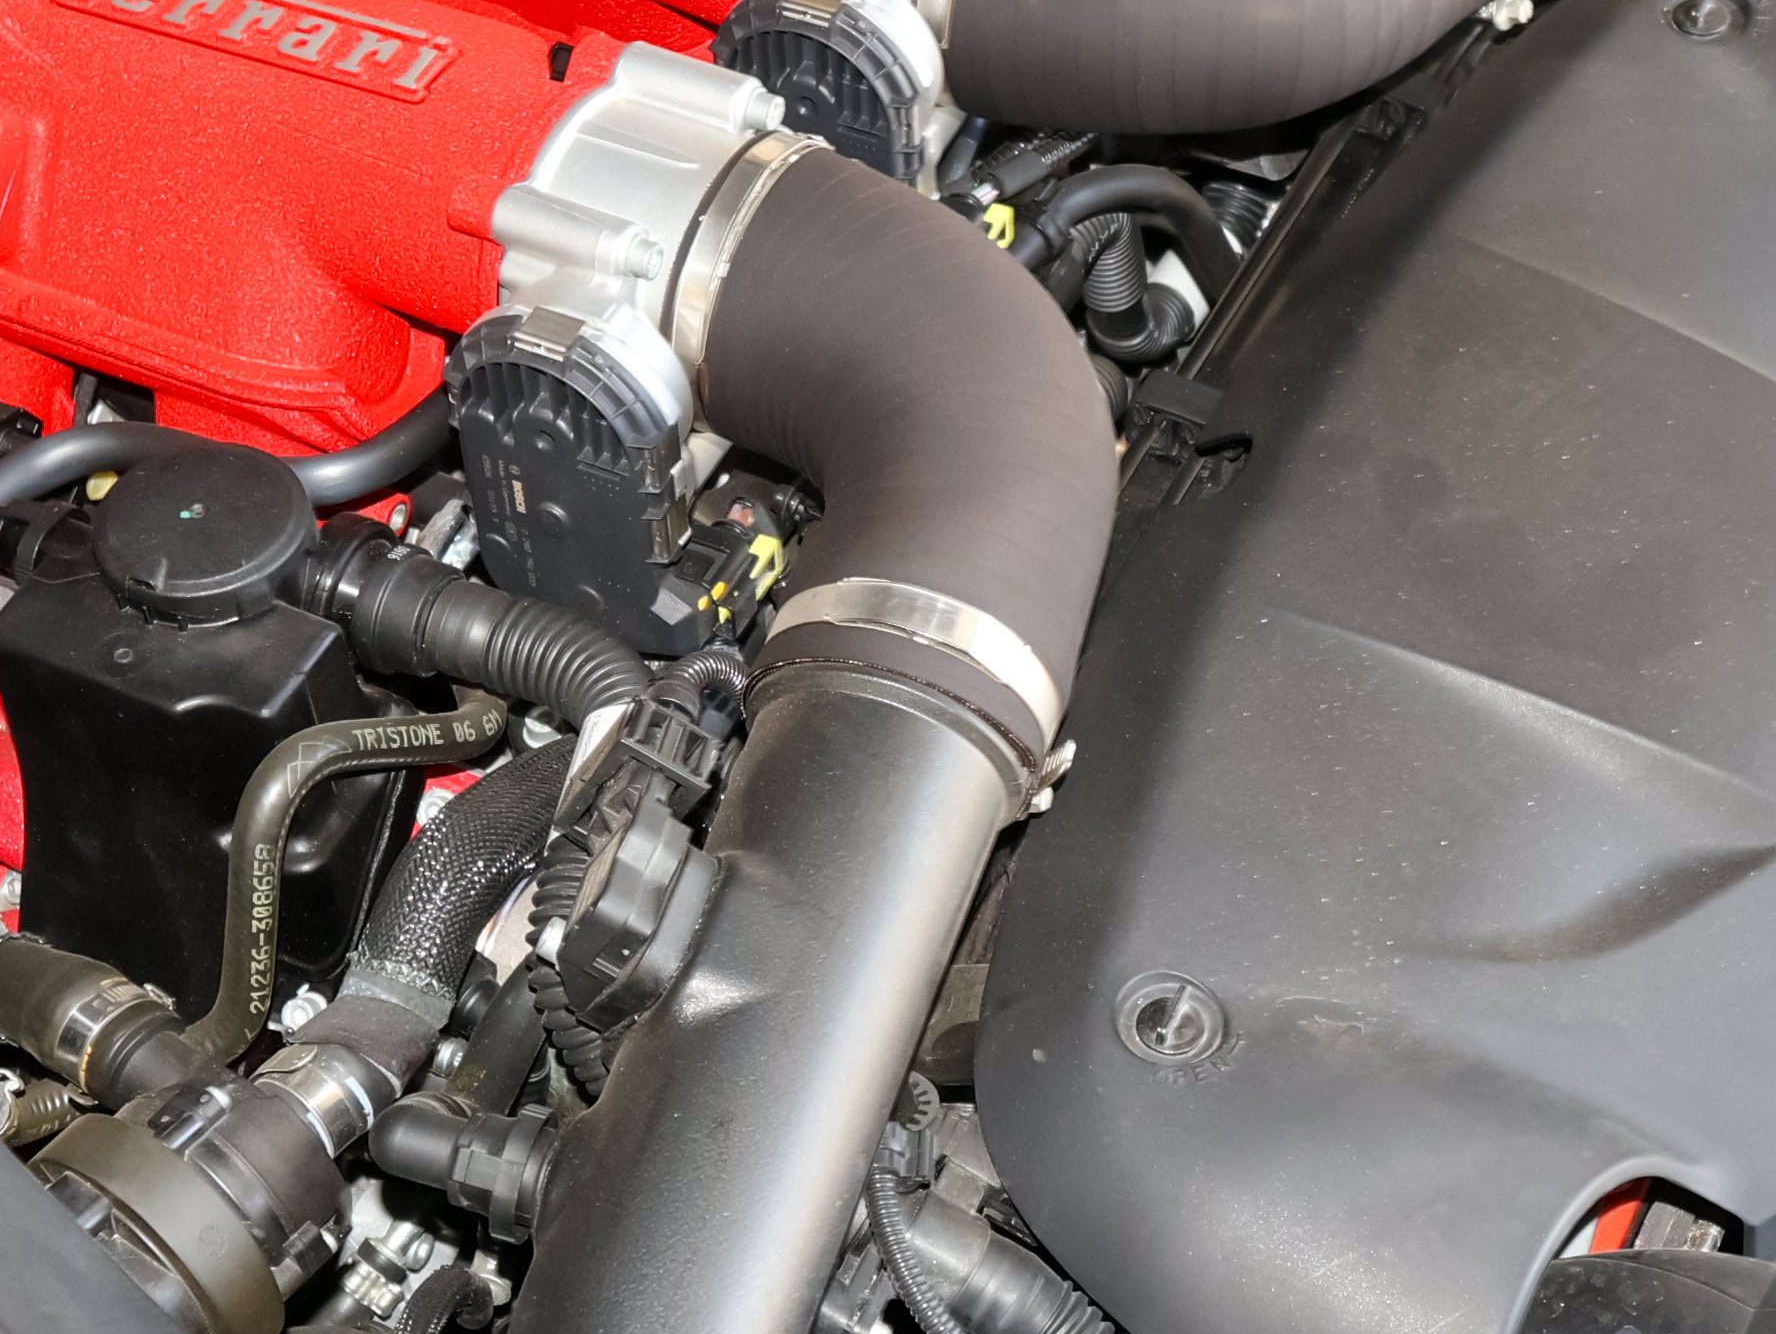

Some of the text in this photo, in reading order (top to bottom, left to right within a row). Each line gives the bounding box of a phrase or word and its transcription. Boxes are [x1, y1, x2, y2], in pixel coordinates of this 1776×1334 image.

[511, 478, 526, 515] BOSCH
[352, 724, 444, 751] TRISTONE
[453, 722, 475, 743] 06
